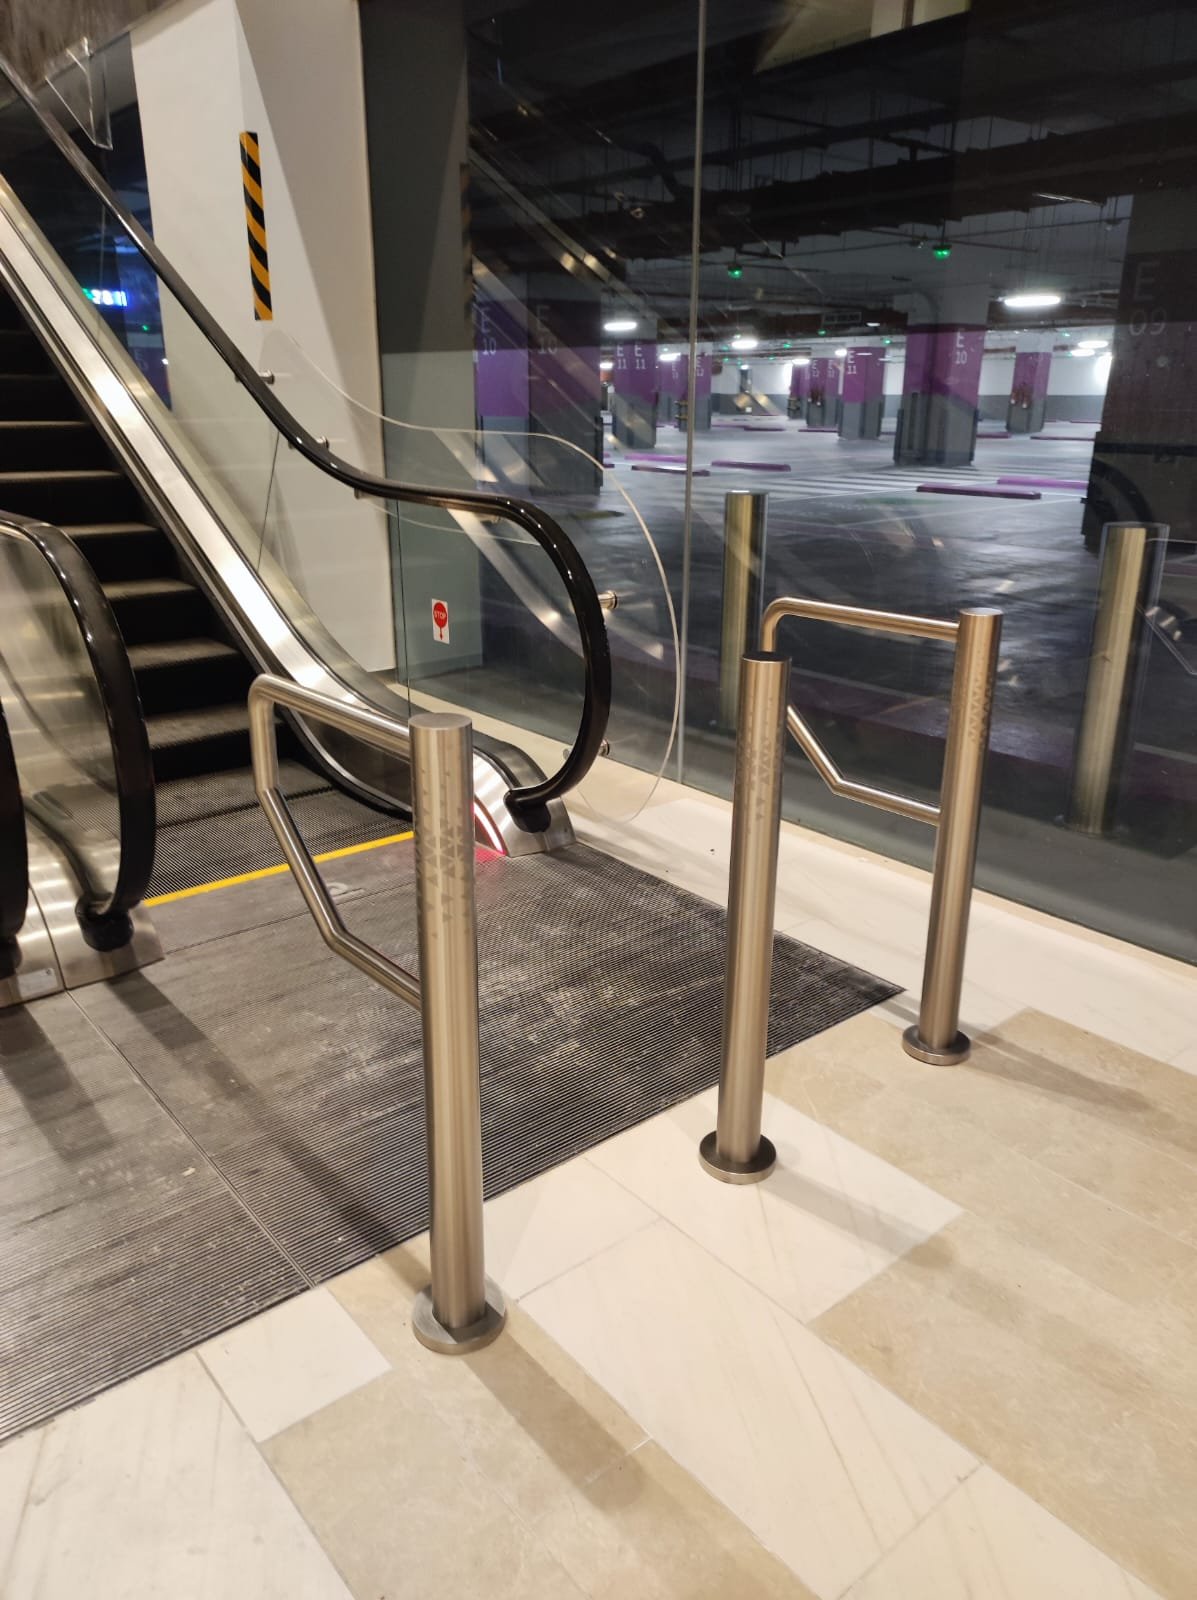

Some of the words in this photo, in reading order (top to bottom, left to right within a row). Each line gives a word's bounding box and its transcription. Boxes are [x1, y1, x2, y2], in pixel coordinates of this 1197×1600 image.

[1133, 262, 1160, 301] E
[481, 307, 490, 333] E
[1129, 307, 1167, 336] 09
[956, 327, 965, 348] E
[482, 337, 497, 356] 10
[847, 350, 856, 364] E
[955, 351, 968, 365] 10
[617, 359, 627, 370] 11
[635, 359, 646, 370] 11
[847, 365, 857, 375] 11
[433, 609, 448, 620] STOP
